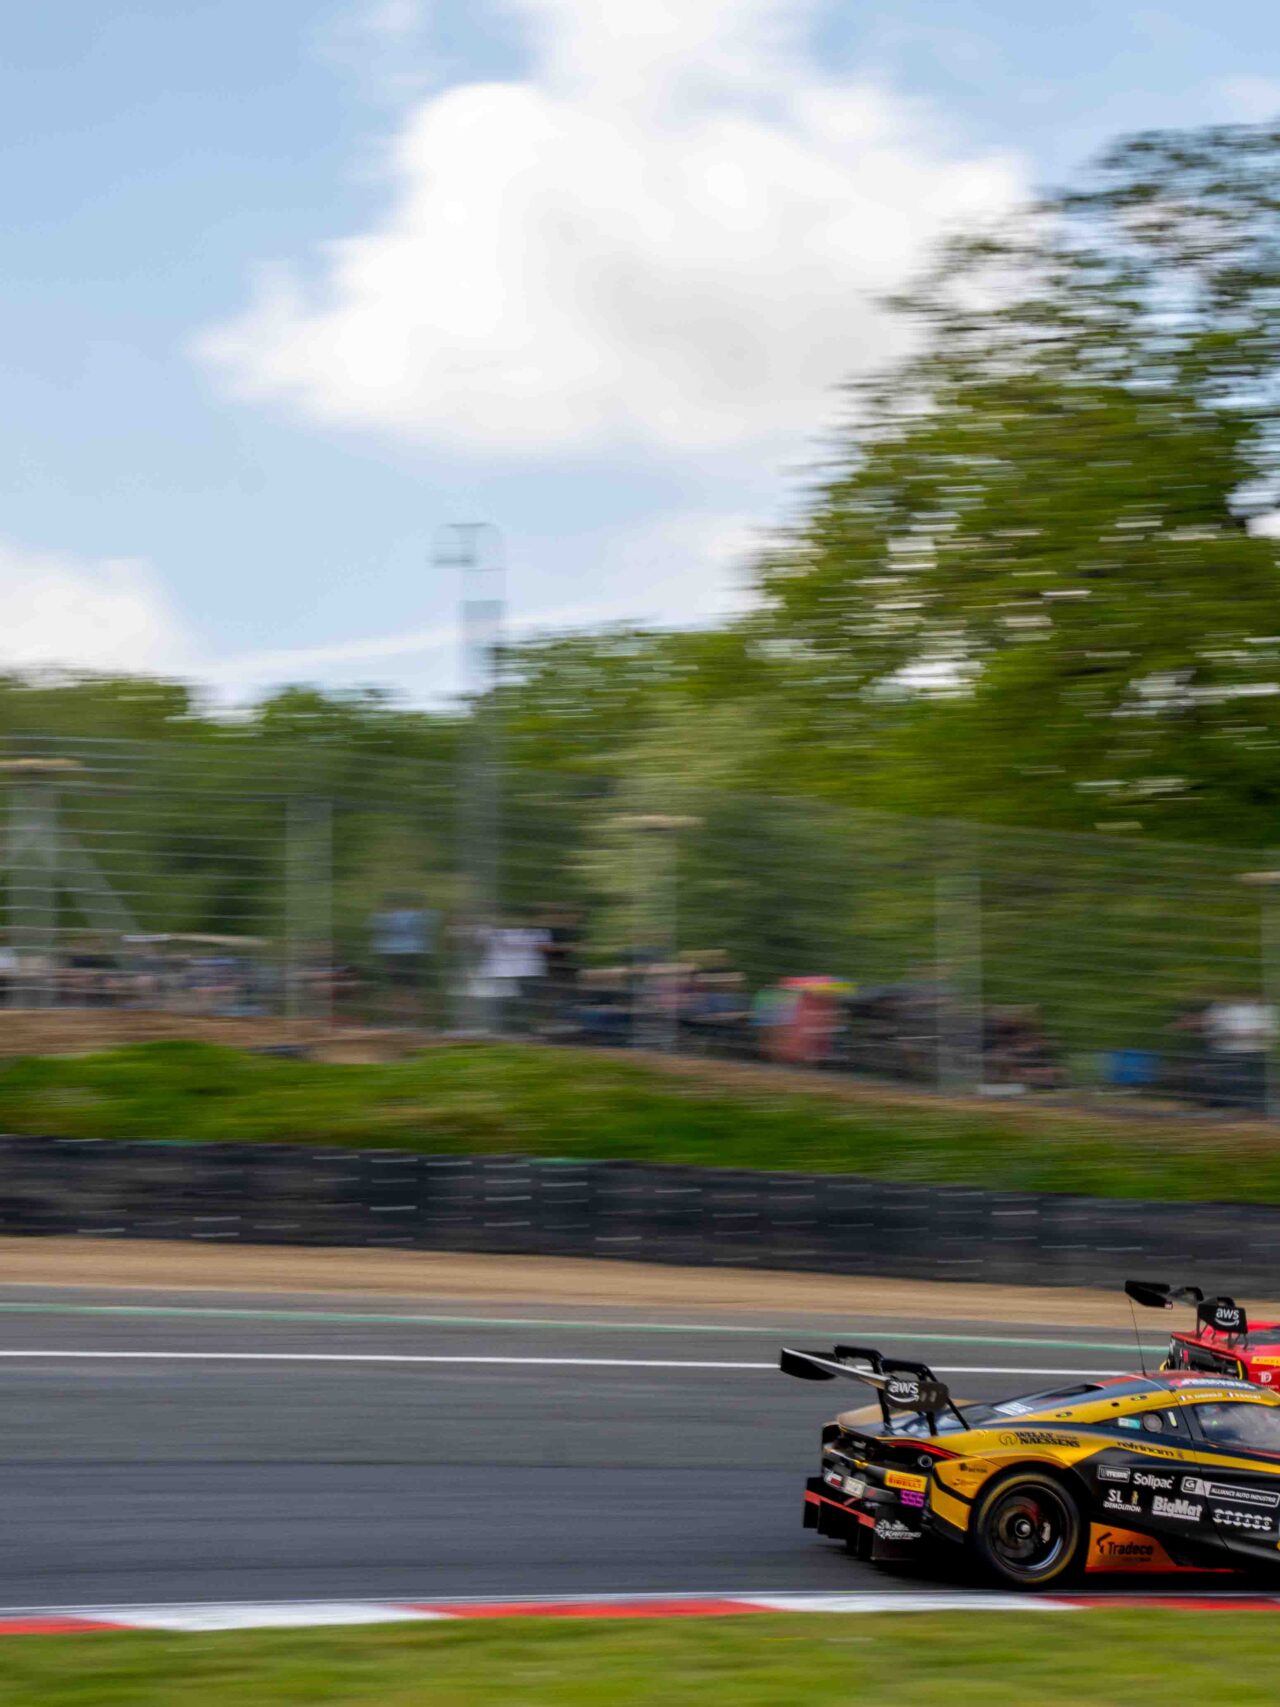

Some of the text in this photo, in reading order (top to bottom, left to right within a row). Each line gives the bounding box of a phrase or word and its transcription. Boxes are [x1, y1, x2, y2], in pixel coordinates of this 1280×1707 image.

[1216, 1307, 1239, 1319] aws
[890, 1381, 918, 1393] aws
[1133, 1473, 1173, 1489] Solipac
[900, 1490, 925, 1507] 555
[1108, 1489, 1122, 1503] SL
[1152, 1495, 1202, 1517] BigMat
